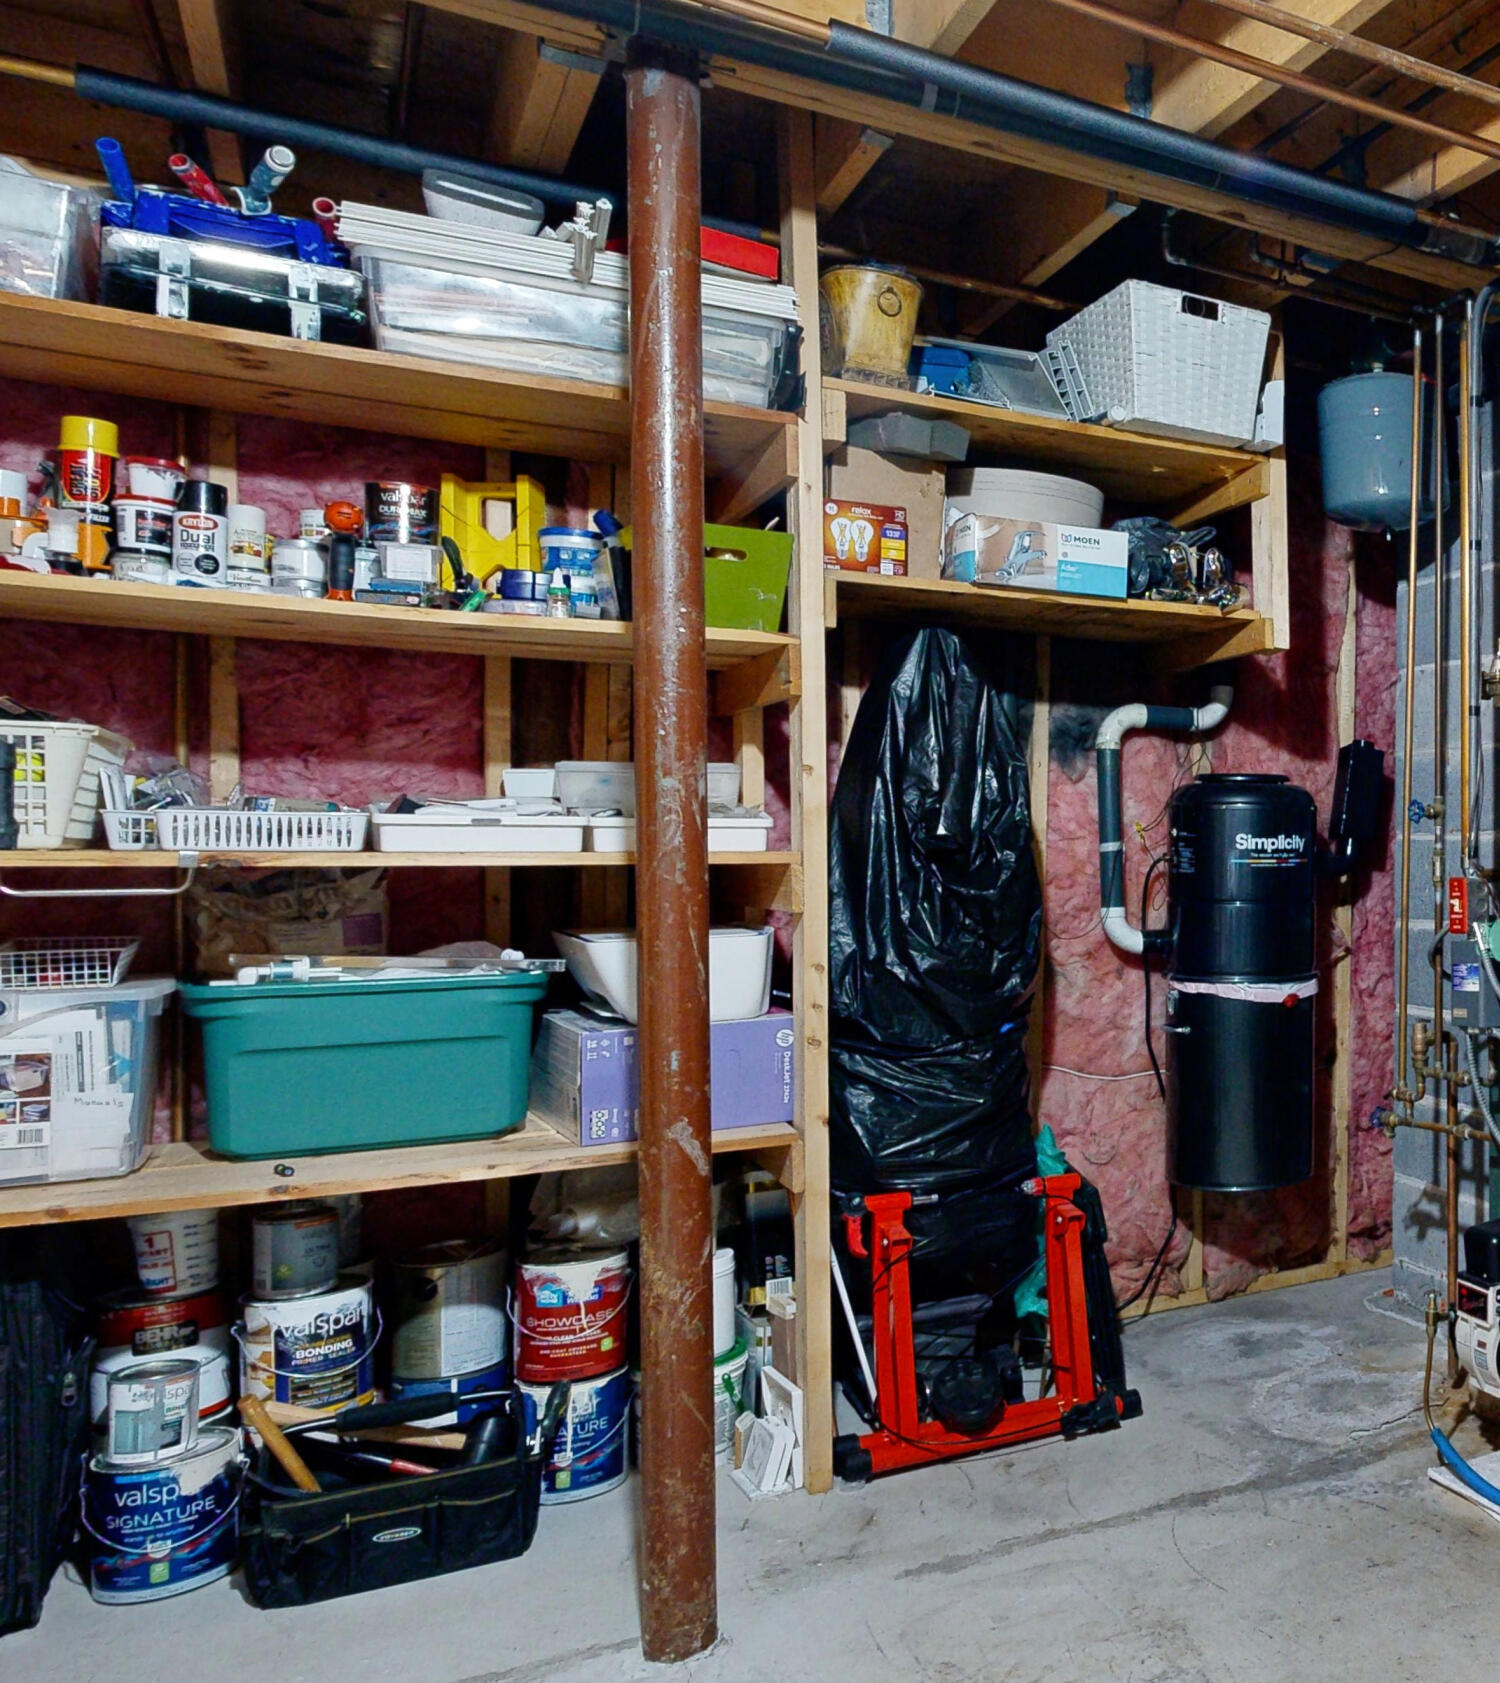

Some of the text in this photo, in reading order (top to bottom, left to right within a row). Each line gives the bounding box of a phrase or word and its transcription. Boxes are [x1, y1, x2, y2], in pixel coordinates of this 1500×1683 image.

[180, 529, 216, 545] Dual
[1073, 536, 1100, 545] MOEN
[1235, 833, 1305, 852] Simplicity
[776, 1029, 794, 1047] hp
[783, 1051, 792, 1083] DeskJet
[280, 1306, 365, 1338] valspar
[527, 1308, 614, 1328] SHOWCASE
[134, 1325, 179, 1344] BEHR
[295, 1339, 353, 1359] BONDING
[106, 1495, 216, 1530] SIGNATURE
